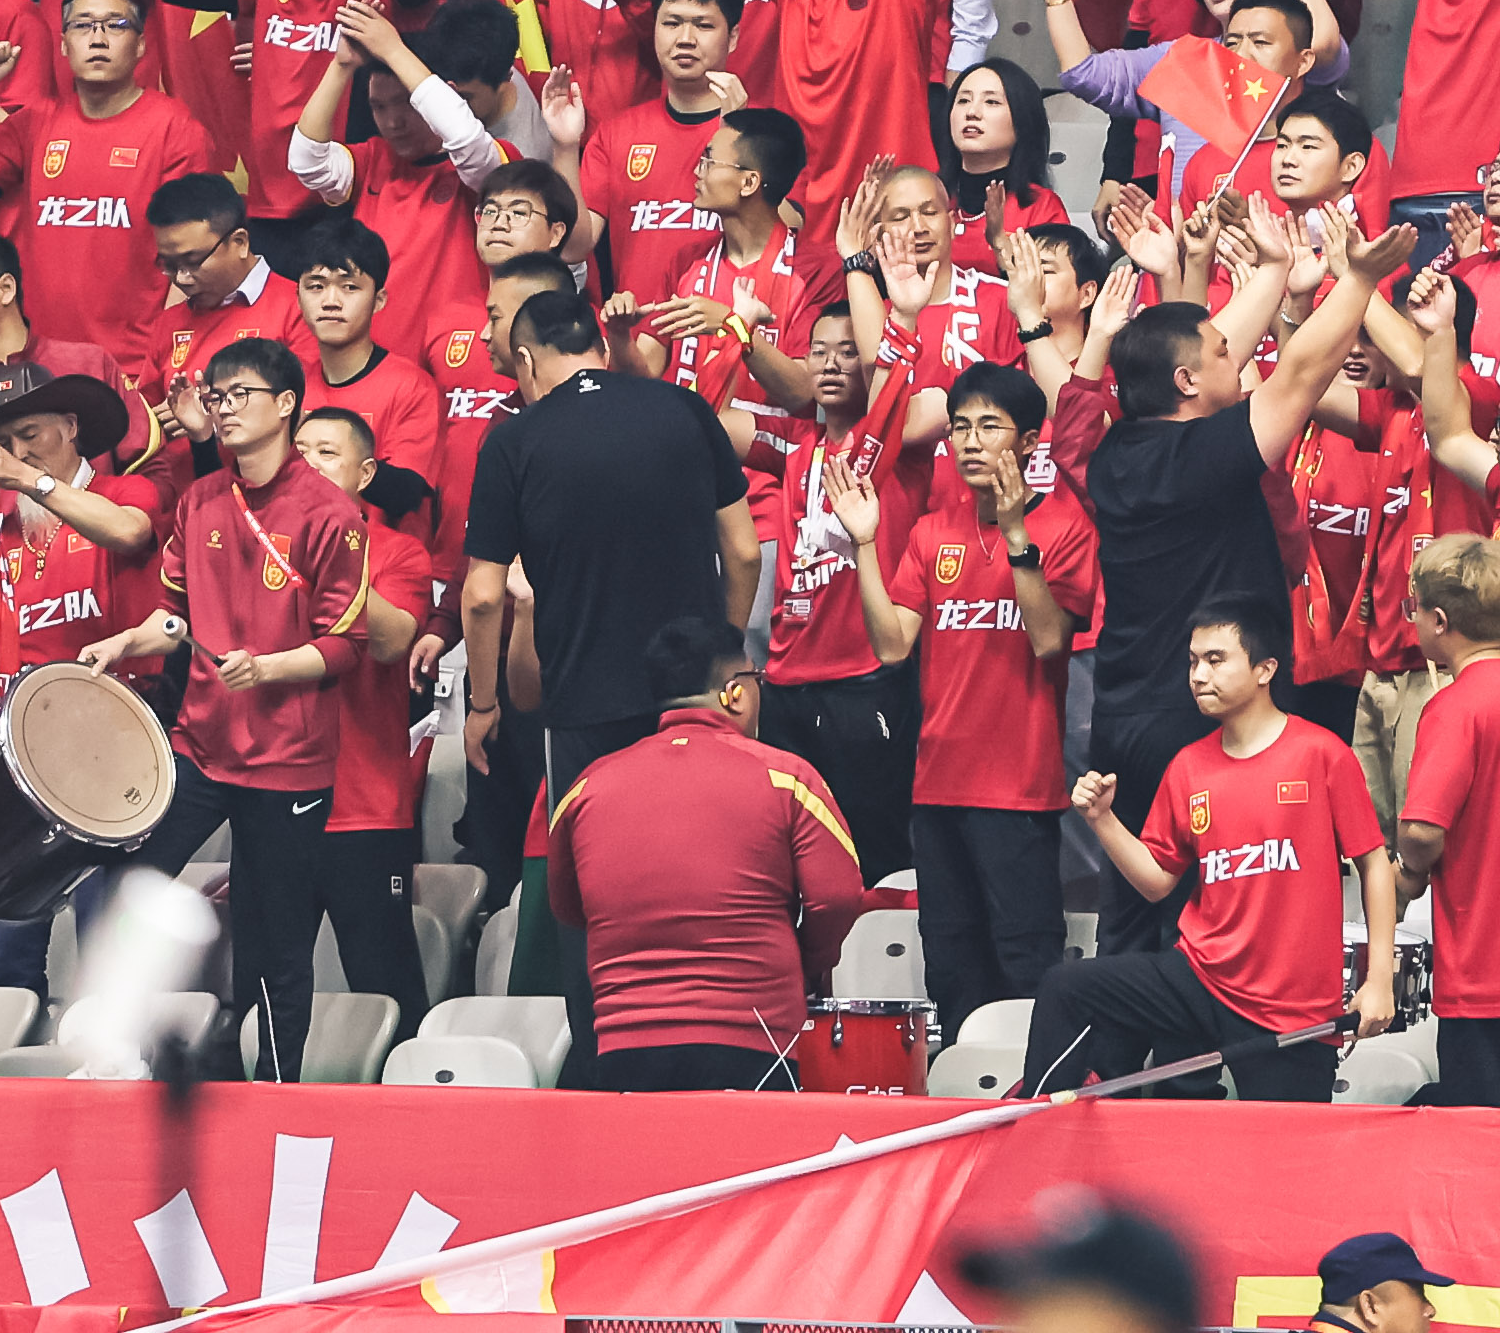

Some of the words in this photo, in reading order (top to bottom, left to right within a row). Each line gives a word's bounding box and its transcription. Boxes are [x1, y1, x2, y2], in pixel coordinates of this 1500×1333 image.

[264, 13, 341, 55] 龙之队
[38, 197, 130, 227] 龙之队
[1200, 839, 1299, 883] 龙之队
